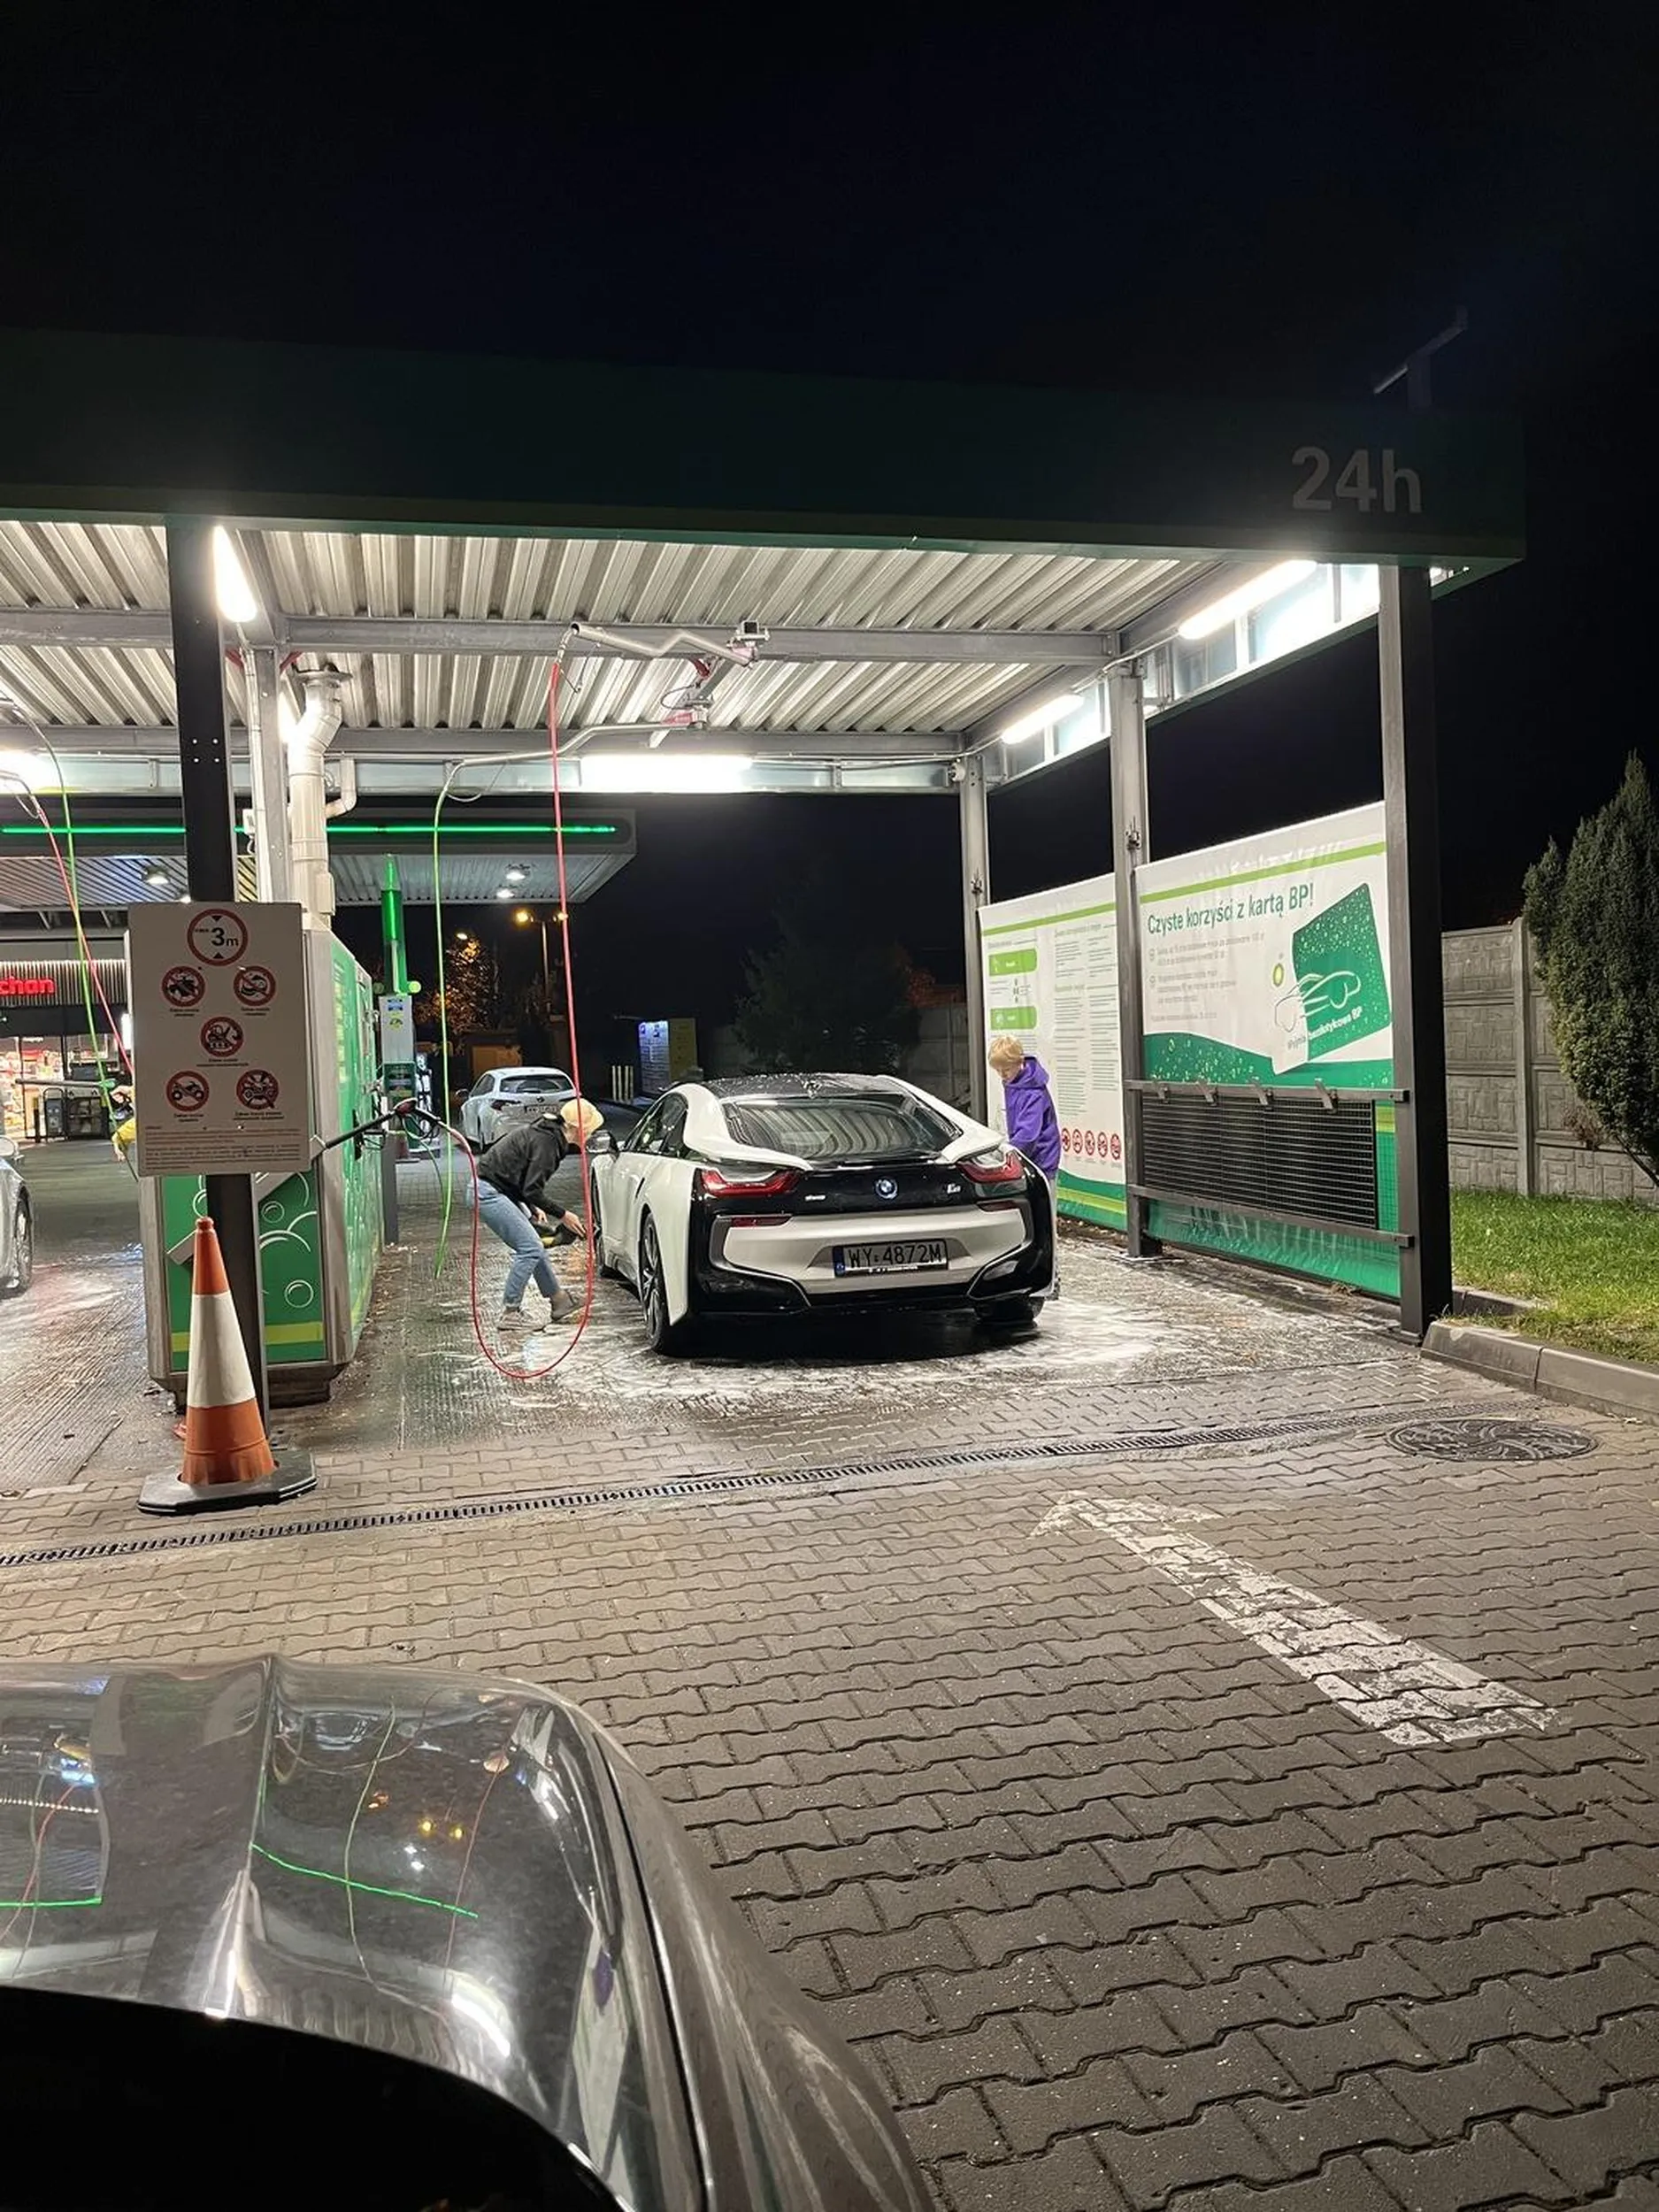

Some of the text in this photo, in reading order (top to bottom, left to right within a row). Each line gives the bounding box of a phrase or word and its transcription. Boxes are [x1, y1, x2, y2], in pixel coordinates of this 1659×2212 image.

[1291, 446, 1423, 514] 24h
[1148, 882, 1314, 937] Czyste korzyści z kartą BP!
[848, 1243, 942, 1268] WY 4872M
